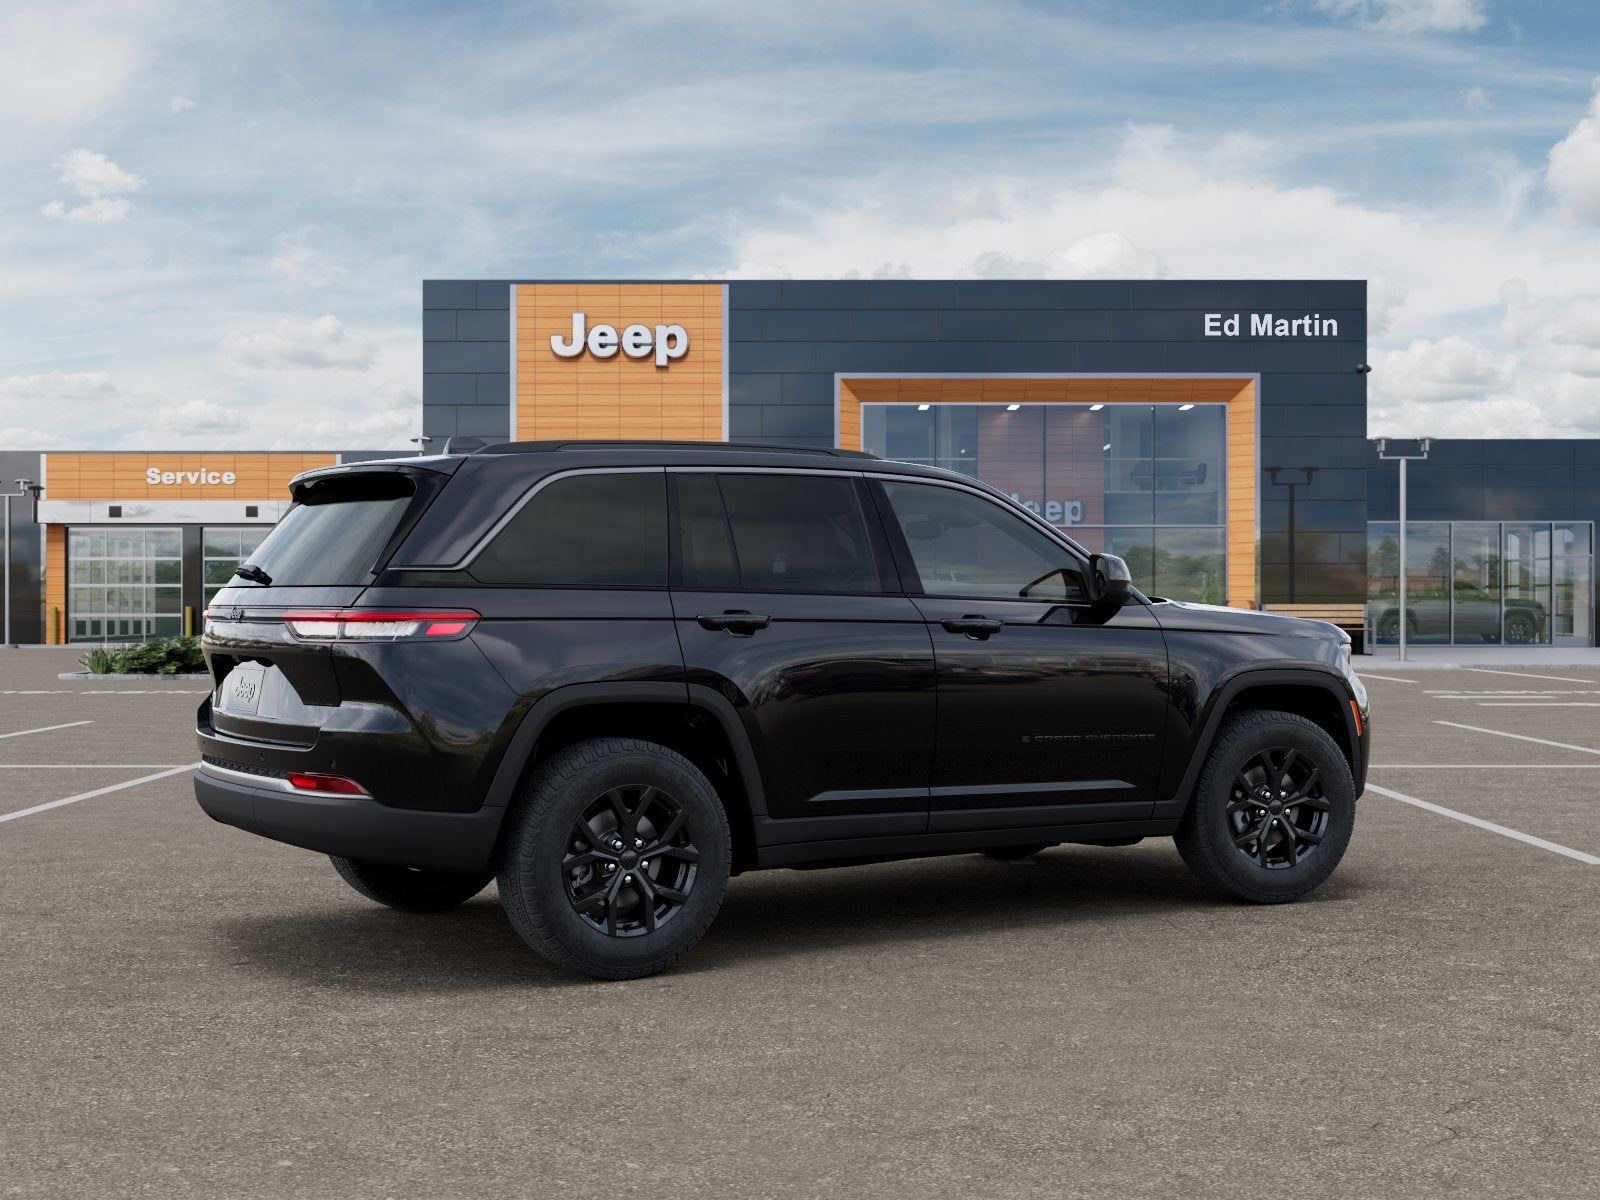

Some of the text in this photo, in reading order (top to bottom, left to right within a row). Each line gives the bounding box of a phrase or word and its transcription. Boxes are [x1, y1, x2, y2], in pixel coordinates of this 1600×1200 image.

[1204, 313, 1338, 337] Ed Martin
[550, 312, 689, 368] Jeep
[146, 467, 237, 485] Service
